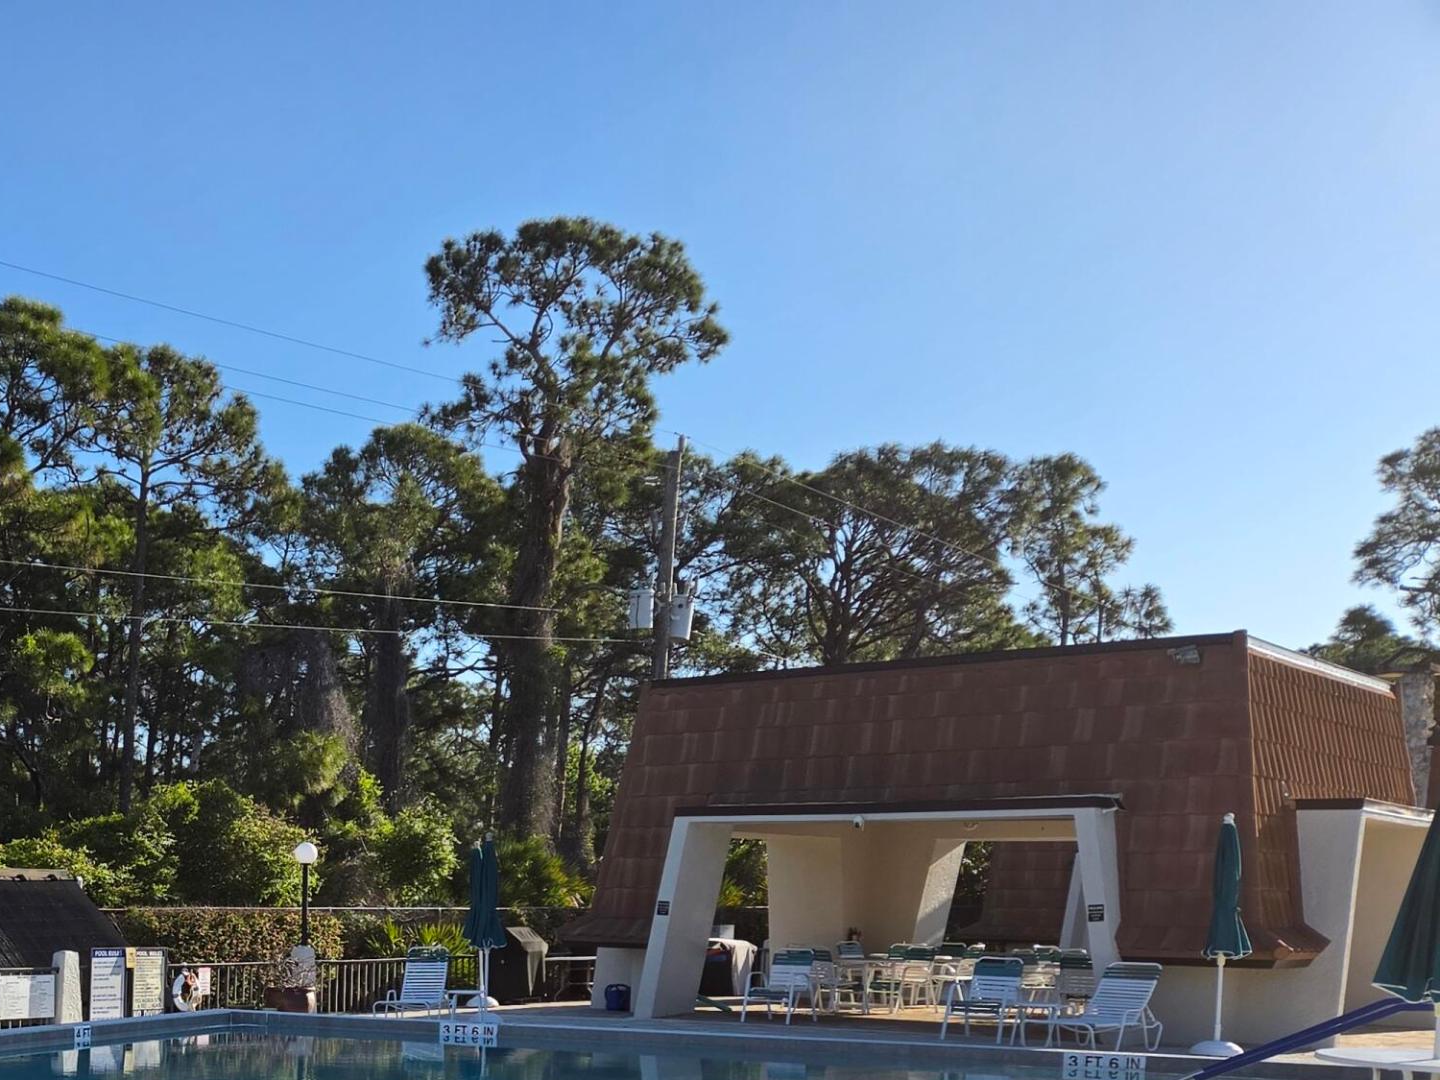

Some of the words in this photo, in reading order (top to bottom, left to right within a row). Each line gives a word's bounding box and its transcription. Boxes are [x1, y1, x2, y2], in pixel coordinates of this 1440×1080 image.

[443, 1025, 450, 1034] 3
[455, 1025, 468, 1035] FT
[471, 1026, 479, 1036] 6
[483, 1026, 494, 1036] IN
[1068, 1055, 1078, 1067] 3
[1109, 1057, 1119, 1069] 6
